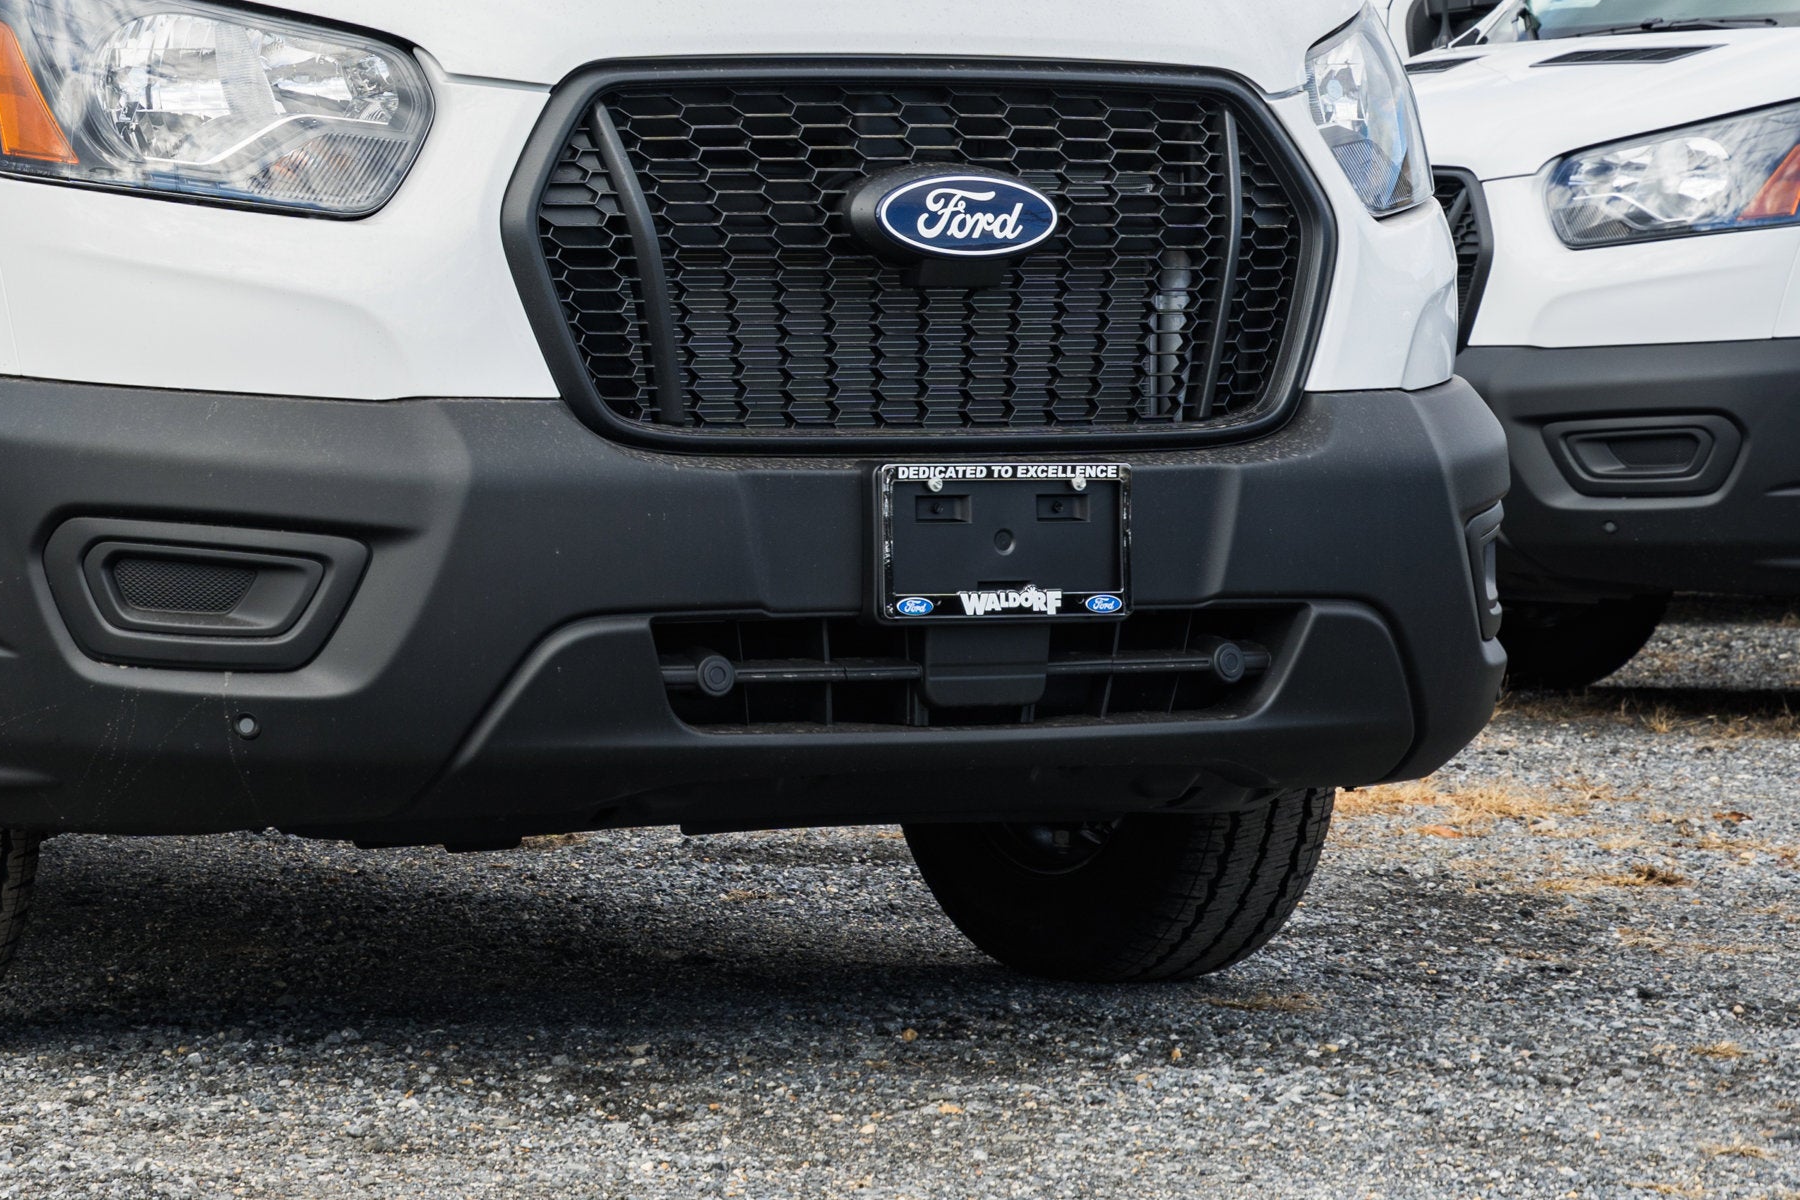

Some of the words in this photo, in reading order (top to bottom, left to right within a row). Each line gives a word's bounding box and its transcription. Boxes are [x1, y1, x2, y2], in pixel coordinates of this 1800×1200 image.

[917, 188, 1023, 240] Ford
[898, 466, 987, 479] DEDICATED
[991, 466, 1013, 478] TO
[1017, 465, 1118, 478] EXCELLENCE
[904, 599, 926, 613] Ford
[958, 588, 1062, 616] WALDORF
[1092, 598, 1115, 611] Ford
